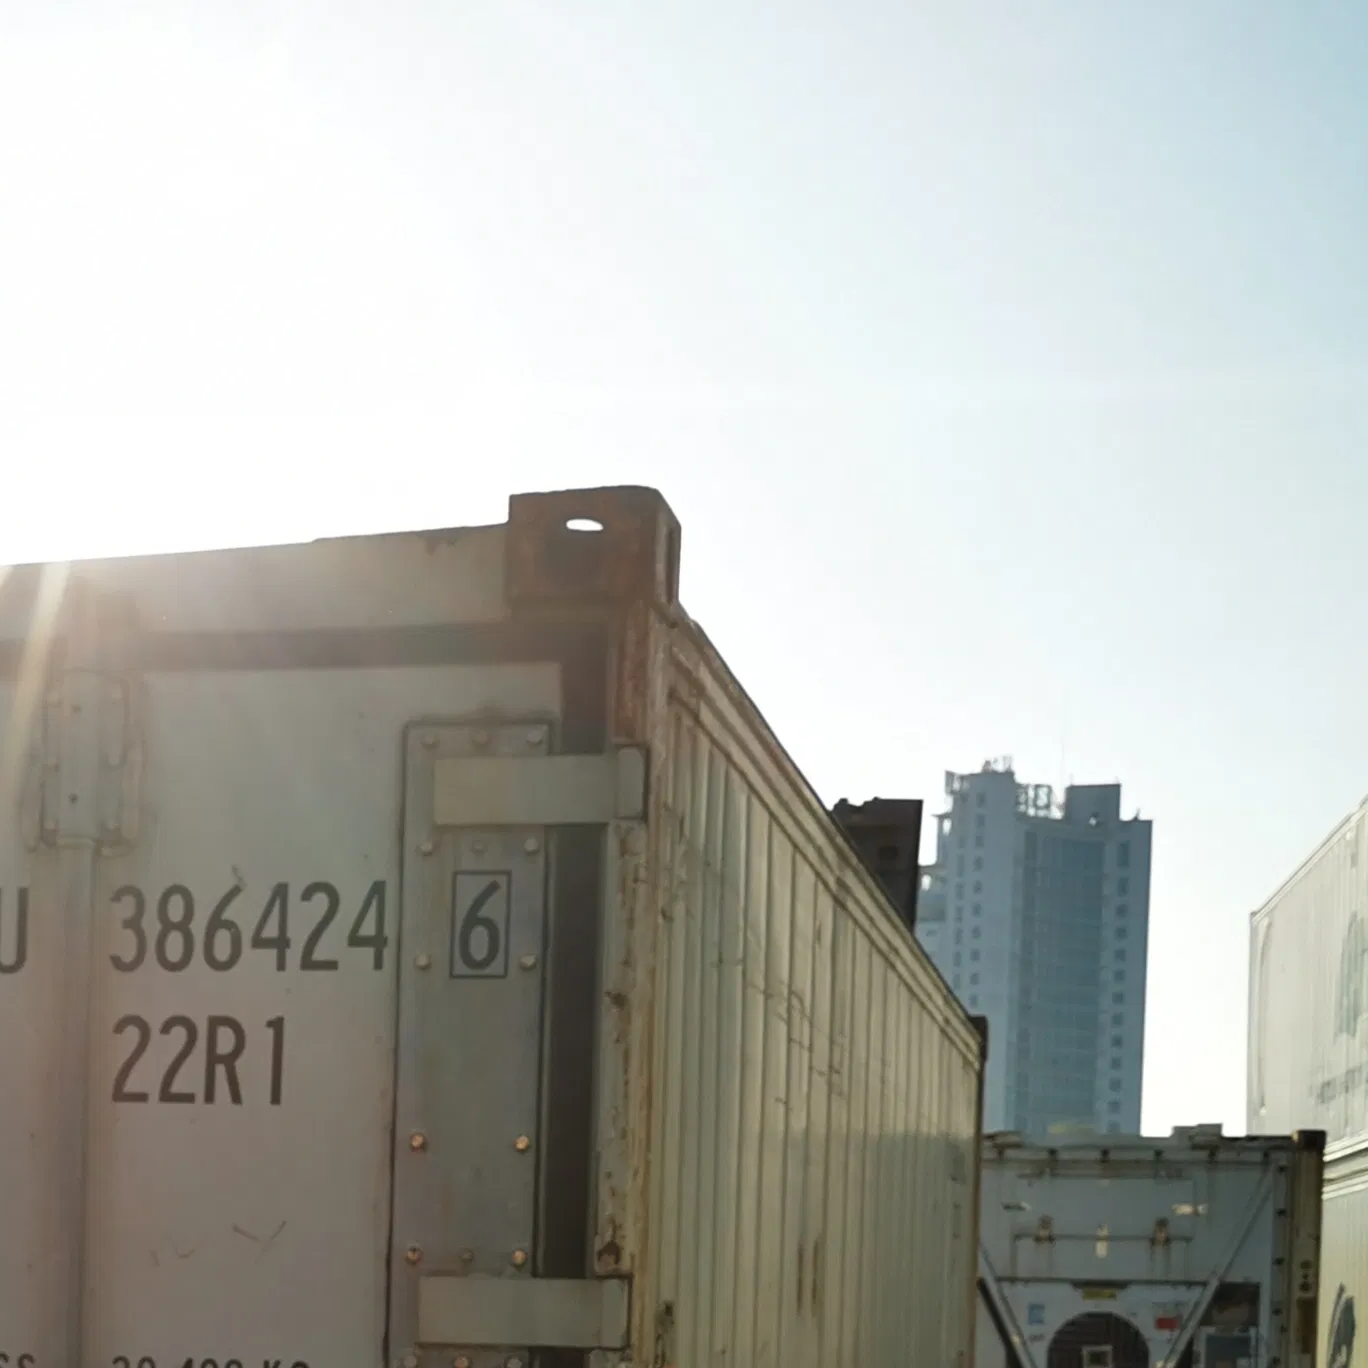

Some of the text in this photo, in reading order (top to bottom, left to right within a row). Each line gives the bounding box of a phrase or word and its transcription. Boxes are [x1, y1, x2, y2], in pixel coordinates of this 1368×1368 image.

[109, 879, 388, 973] 386424
[456, 877, 505, 973] 6
[111, 1013, 286, 1106] 22R1
